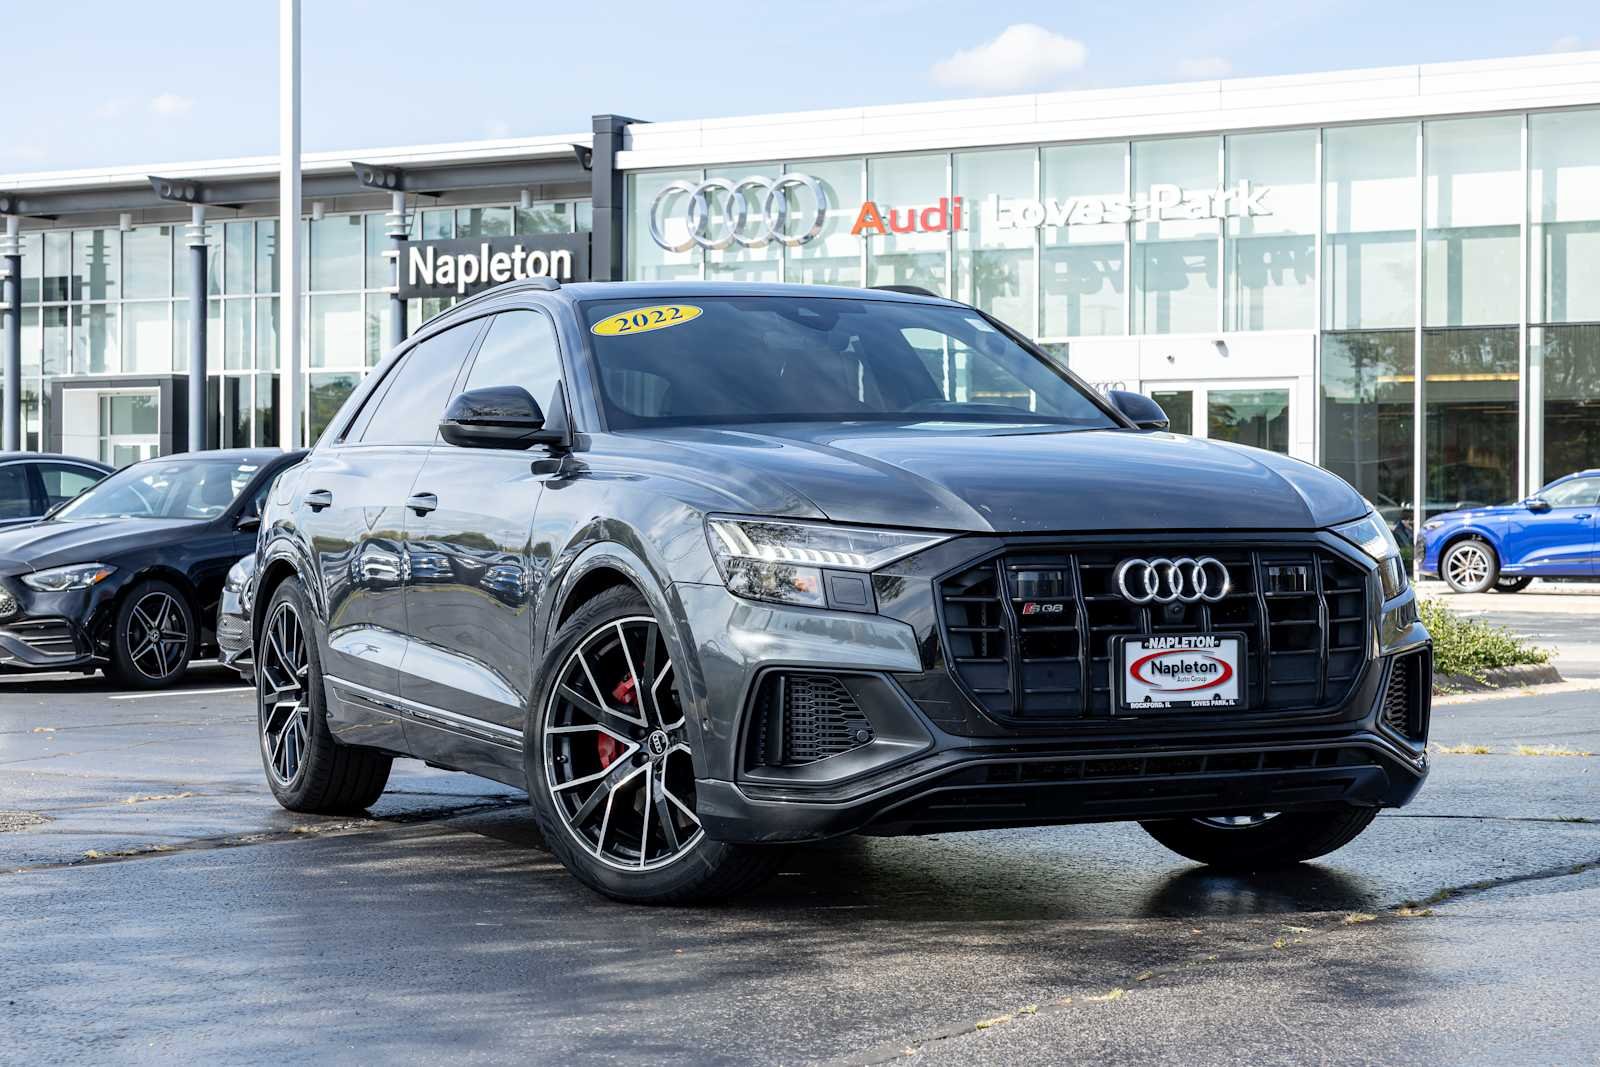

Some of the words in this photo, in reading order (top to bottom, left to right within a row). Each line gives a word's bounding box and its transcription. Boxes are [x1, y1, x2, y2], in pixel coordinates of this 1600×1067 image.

[850, 196, 964, 236] Audi
[988, 194, 1133, 230] Loves
[1149, 179, 1273, 219] Park
[408, 243, 572, 294] Napleton
[614, 307, 684, 333] 2022
[1149, 637, 1215, 649] NAPLETON
[1151, 660, 1217, 677] Napleton
[1191, 675, 1207, 683] Group
